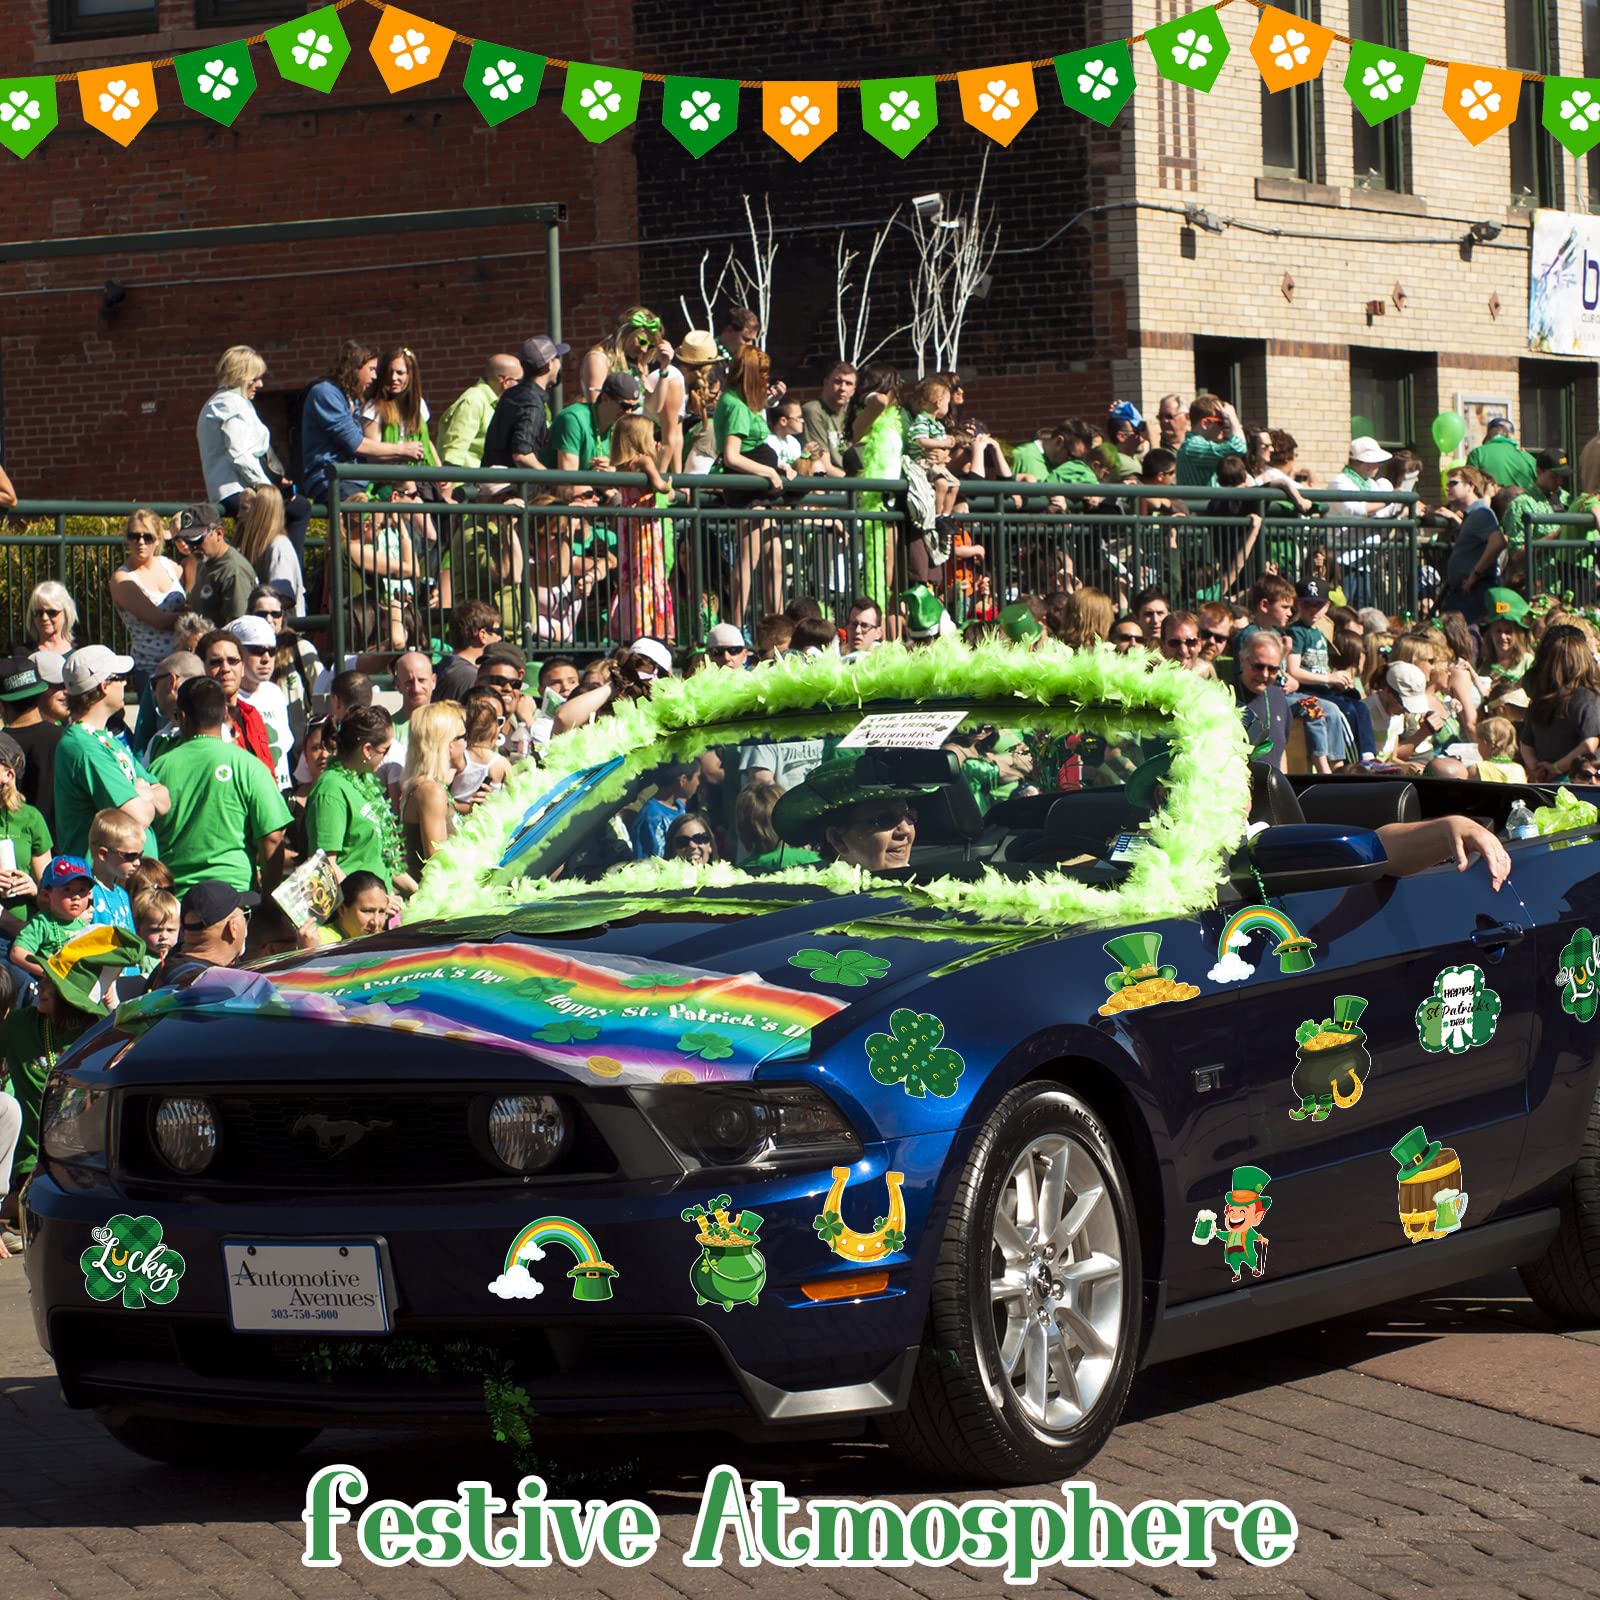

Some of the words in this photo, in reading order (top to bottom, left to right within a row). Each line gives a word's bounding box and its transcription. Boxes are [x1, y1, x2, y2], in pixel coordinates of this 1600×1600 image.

[856, 730, 935, 740] Automotive
[544, 994, 615, 1019] Happy
[620, 1006, 659, 1017] St.
[667, 1002, 780, 1032] Patrick's
[1074, 1108, 1107, 1145] NERO
[231, 1260, 360, 1288] Automotive
[289, 1287, 376, 1307] Avenues
[271, 1308, 339, 1320] 303-750-5000
